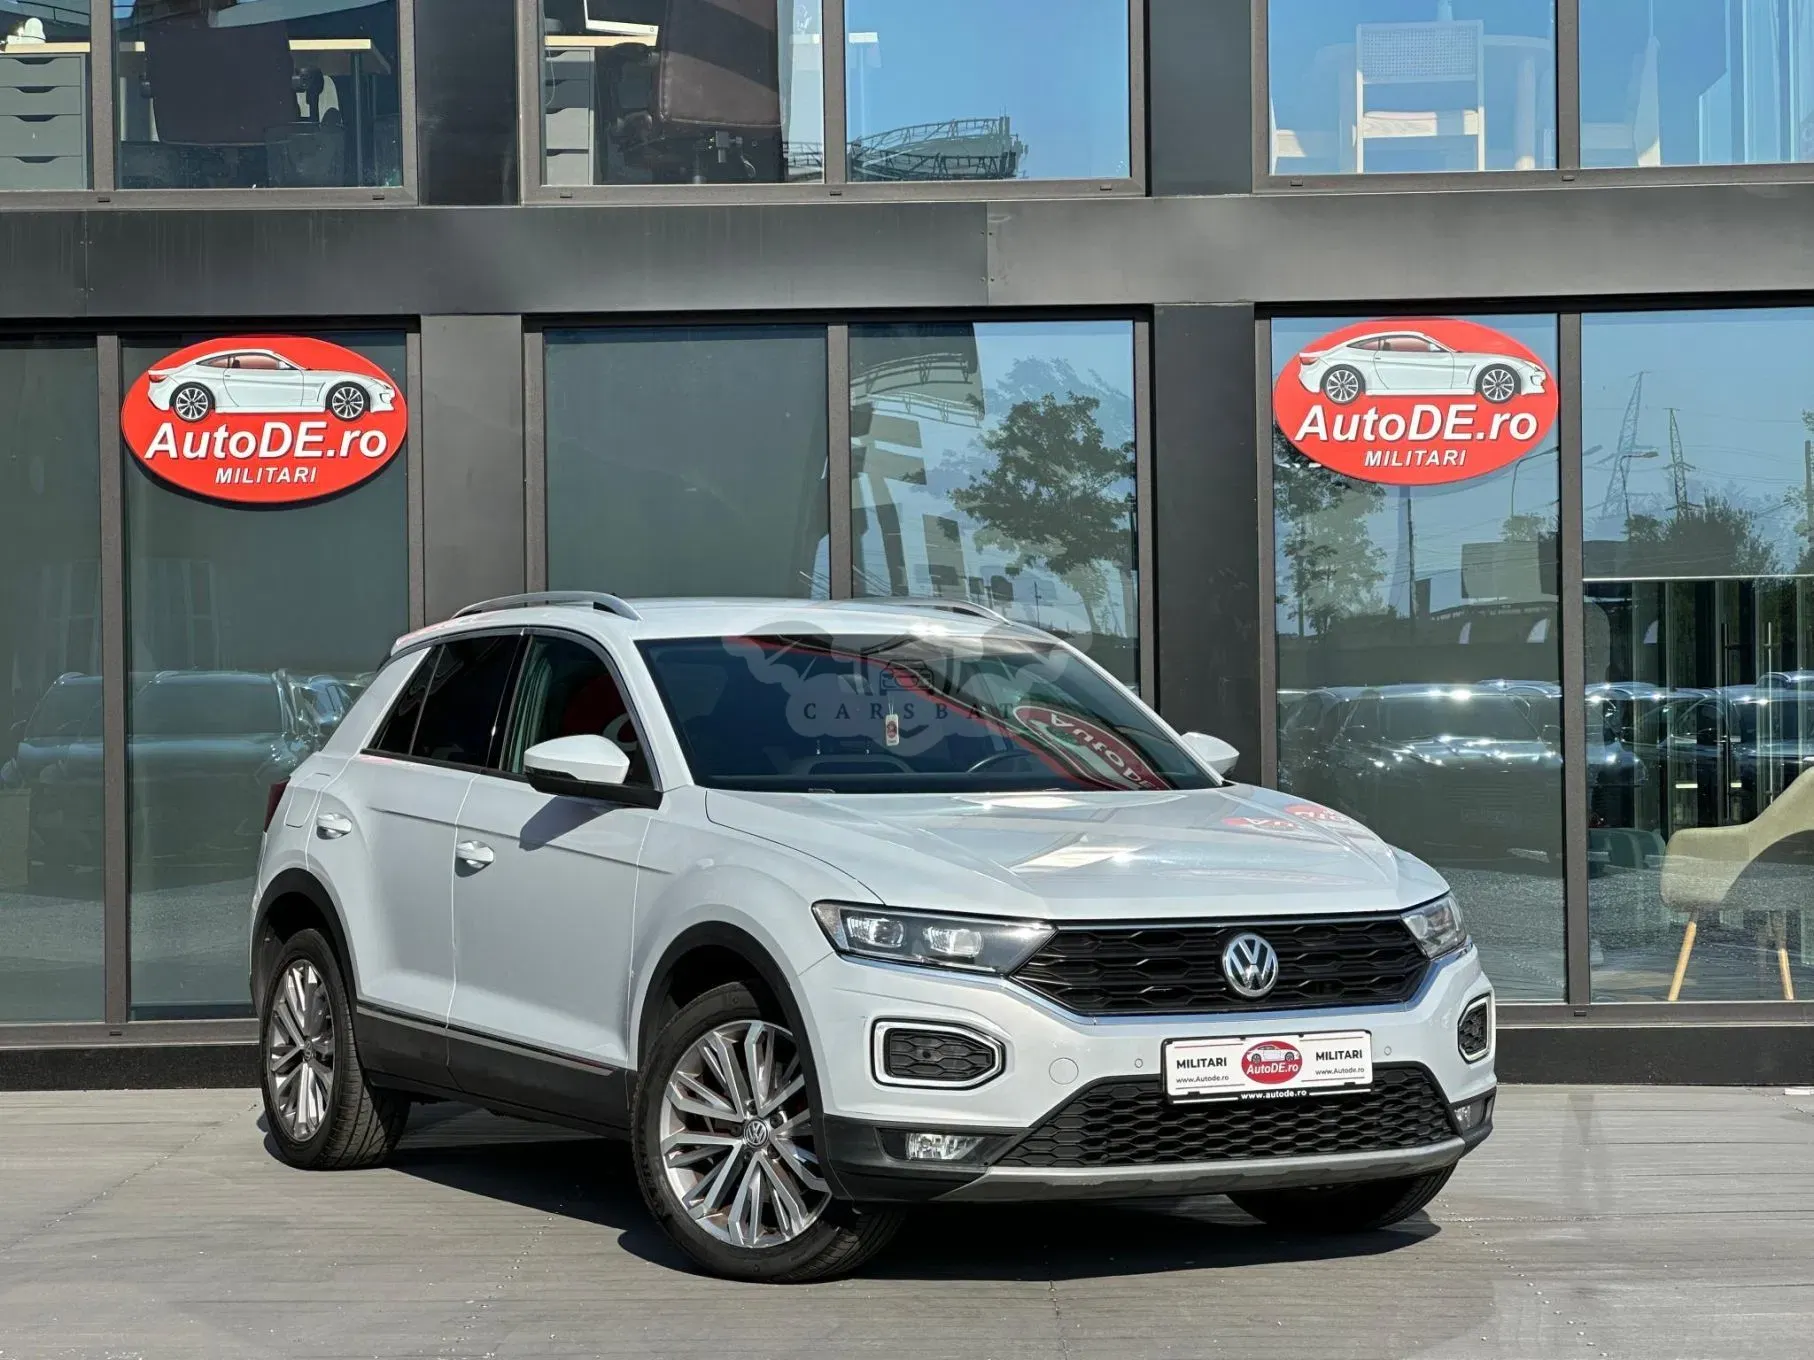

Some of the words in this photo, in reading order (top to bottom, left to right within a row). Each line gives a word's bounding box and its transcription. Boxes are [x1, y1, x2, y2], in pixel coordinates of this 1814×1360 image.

[1294, 404, 1538, 442] AutoDE.ro
[144, 421, 388, 459] AutoDE.ro
[1364, 450, 1466, 467] MILITARI
[215, 466, 317, 485] MILITARI
[1315, 1049, 1364, 1061] MILITARI
[1176, 1057, 1228, 1070] MILITARI
[1246, 1061, 1299, 1075] AutoDE.ro
[1315, 1066, 1365, 1076] www.Autode.ro
[1176, 1074, 1230, 1083] www.Autode.ro
[1240, 1089, 1307, 1100] www.autode.ro
